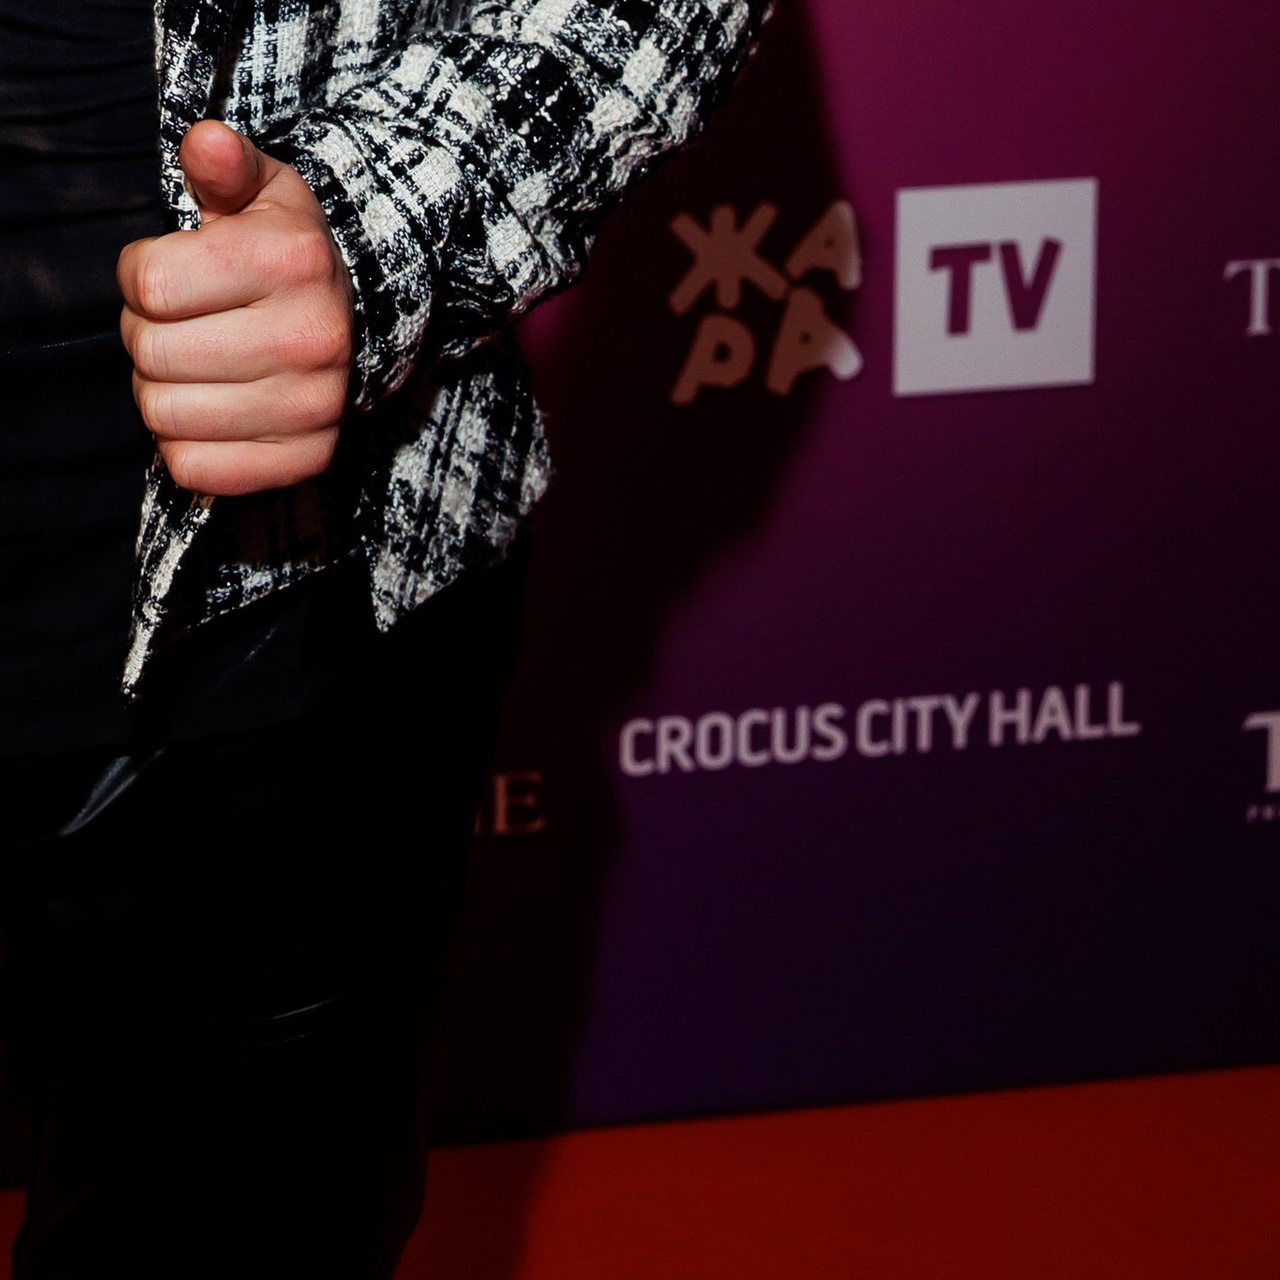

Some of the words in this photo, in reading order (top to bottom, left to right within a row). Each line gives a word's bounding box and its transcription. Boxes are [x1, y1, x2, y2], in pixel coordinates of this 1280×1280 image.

[928, 236, 1062, 336] TV
[619, 704, 849, 777] CROCUS
[856, 692, 979, 757] CITY
[988, 681, 1141, 747] HALL
